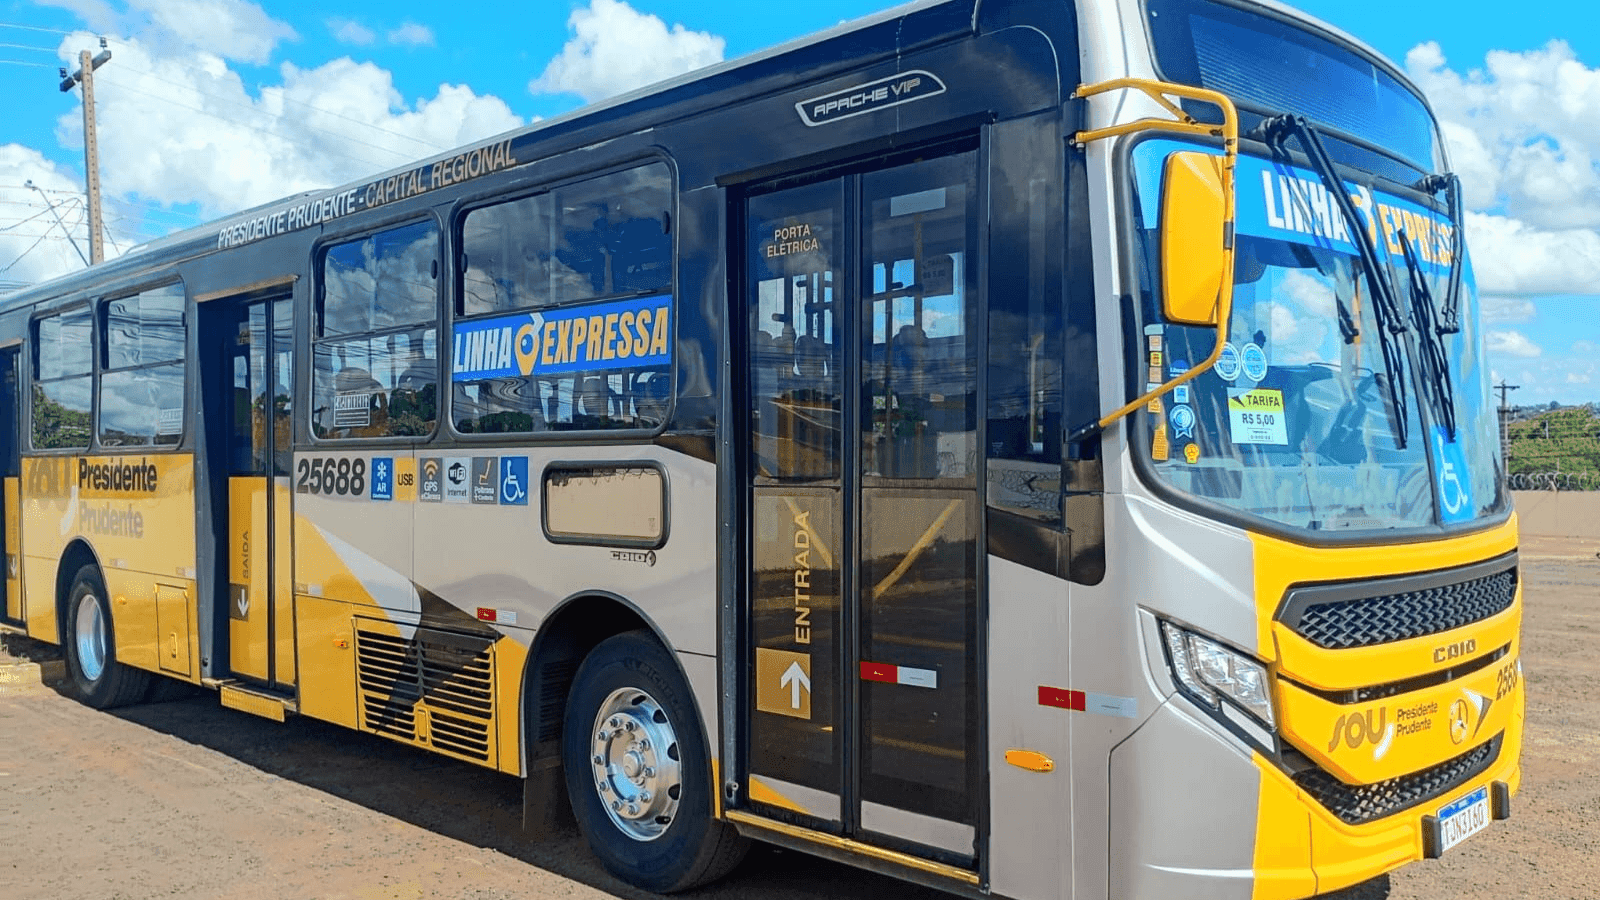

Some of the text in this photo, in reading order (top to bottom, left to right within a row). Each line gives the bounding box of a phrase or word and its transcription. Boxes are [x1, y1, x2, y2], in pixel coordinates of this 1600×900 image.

[814, 78, 920, 117] APACHE VIP
[217, 211, 285, 249] PRESIDENTE
[288, 188, 357, 231] PRUDENTE
[366, 167, 427, 208] CAPITAL
[431, 138, 516, 188] REGIONAL
[1262, 169, 1351, 243] LINHA
[767, 237, 818, 258] ELÉTRICA
[774, 224, 811, 242] PORTA
[453, 307, 668, 373] LINHA EXPRESSA
[1246, 394, 1280, 407] TARIFA
[1256, 414, 1275, 427] 5,00
[79, 457, 158, 492] Presidente
[296, 458, 366, 496] 25688
[376, 483, 387, 492] AR
[397, 473, 414, 486] USB
[424, 481, 438, 492] GPS
[80, 501, 144, 539] Prudente
[241, 531, 249, 579] SAÍDA
[794, 510, 811, 644] ENTRADA
[1433, 639, 1476, 664] CAIO
[1397, 701, 1438, 723] Presidente
[1328, 707, 1386, 753] SOU
[1396, 718, 1432, 738] Prudente
